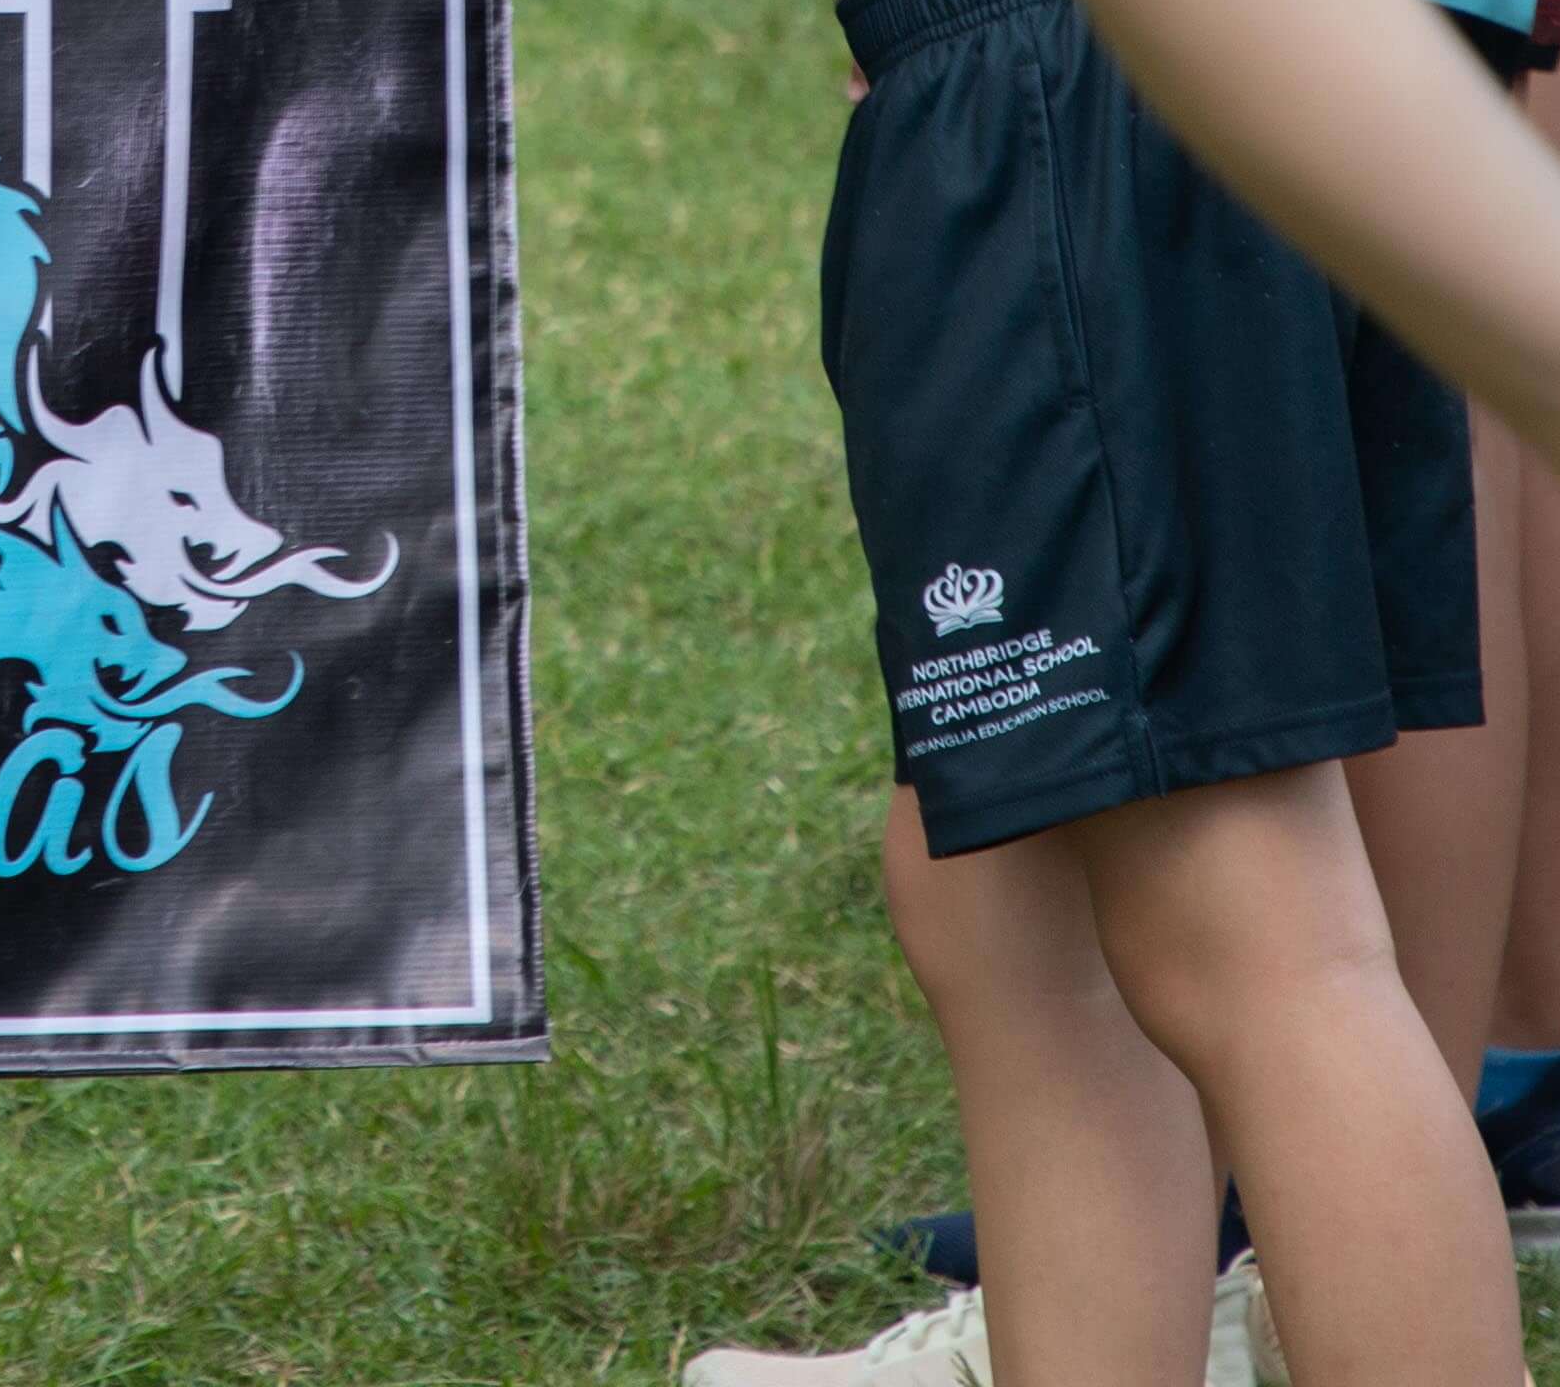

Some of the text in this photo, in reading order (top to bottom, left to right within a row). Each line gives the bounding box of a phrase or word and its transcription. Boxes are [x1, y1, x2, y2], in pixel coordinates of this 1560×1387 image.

[912, 628, 1054, 683] NORTHBRIDGE
[1023, 635, 1101, 678] SCHOOL
[927, 729, 977, 752] ANGLIA
[979, 702, 1048, 740] EDUCATION
[1048, 687, 1110, 714] SCHOOL
[930, 680, 1041, 726] CAMBODIA
